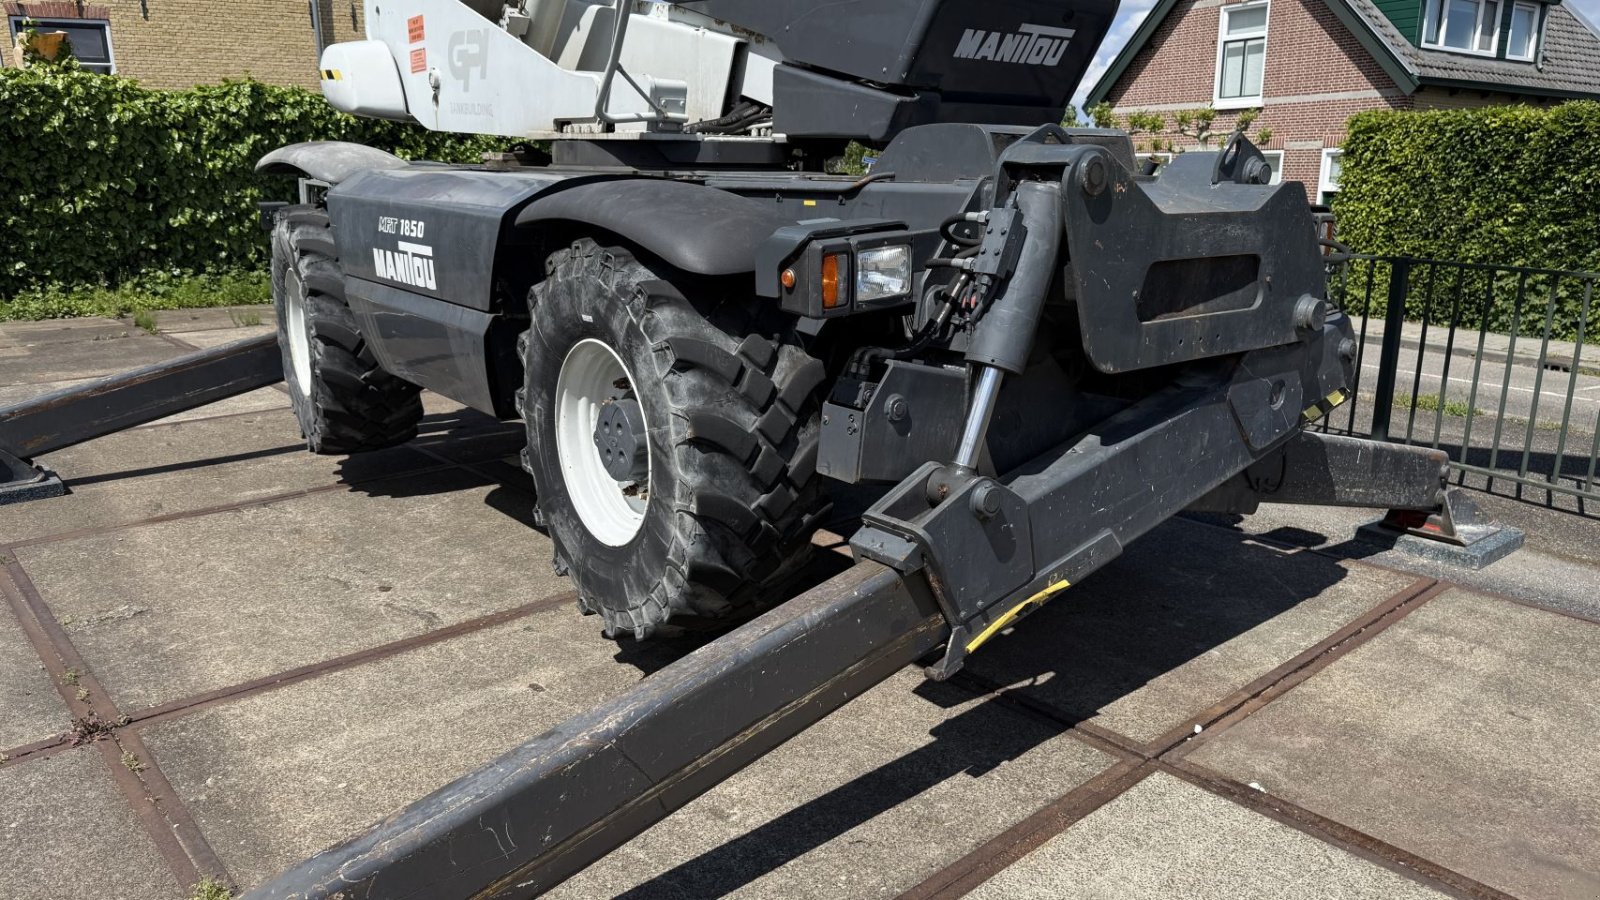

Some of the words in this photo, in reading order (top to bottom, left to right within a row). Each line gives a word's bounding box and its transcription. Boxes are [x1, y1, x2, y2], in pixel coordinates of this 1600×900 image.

[953, 22, 1076, 67] MANITOU
[378, 215, 398, 234] MRT
[400, 218, 425, 238] 1850
[372, 240, 437, 290] MANITOU
